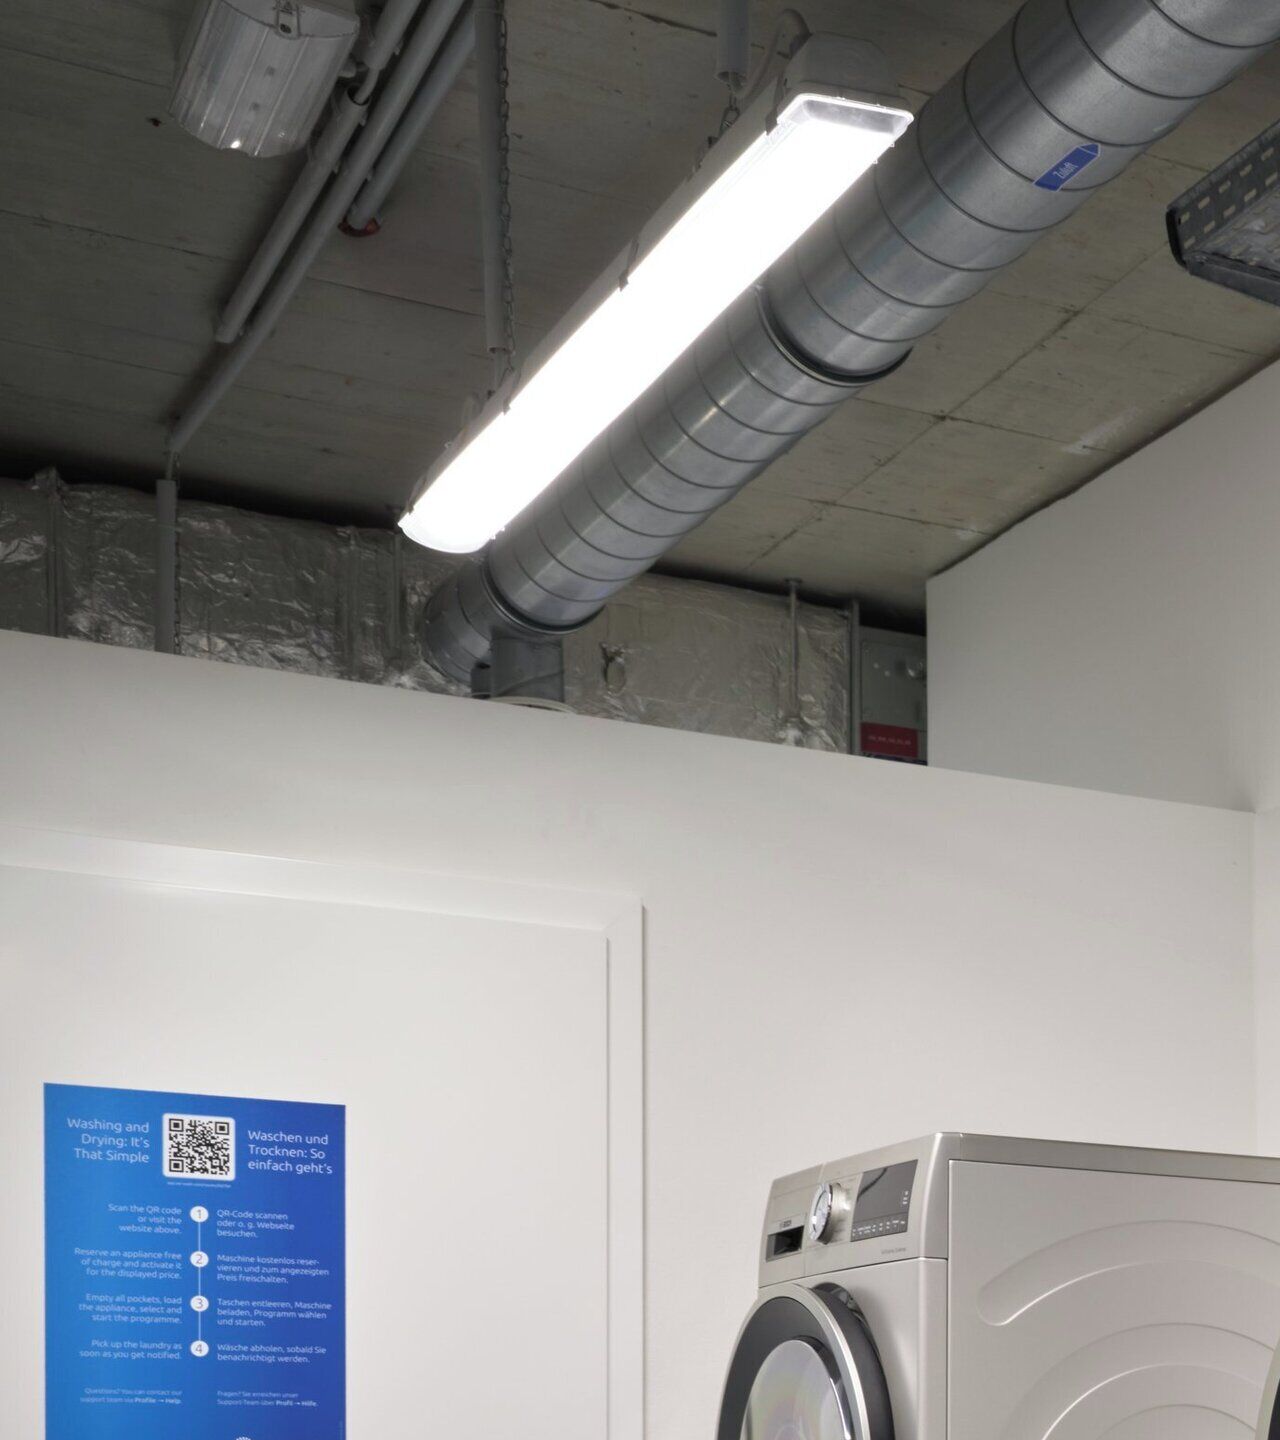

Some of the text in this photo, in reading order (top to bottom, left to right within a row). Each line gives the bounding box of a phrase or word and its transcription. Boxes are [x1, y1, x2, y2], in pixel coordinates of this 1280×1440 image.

[67, 1118, 150, 1132] Washing and
[81, 1133, 127, 1147] Drying:
[248, 1130, 328, 1144] Waschen und
[74, 1148, 149, 1164] That Simple
[248, 1145, 325, 1159] Trocknen: So
[248, 1160, 292, 1171] einfach
[196, 1209, 202, 1219] 1
[196, 1254, 203, 1264] 2
[196, 1299, 203, 1309] 3
[195, 1344, 204, 1354] 4
